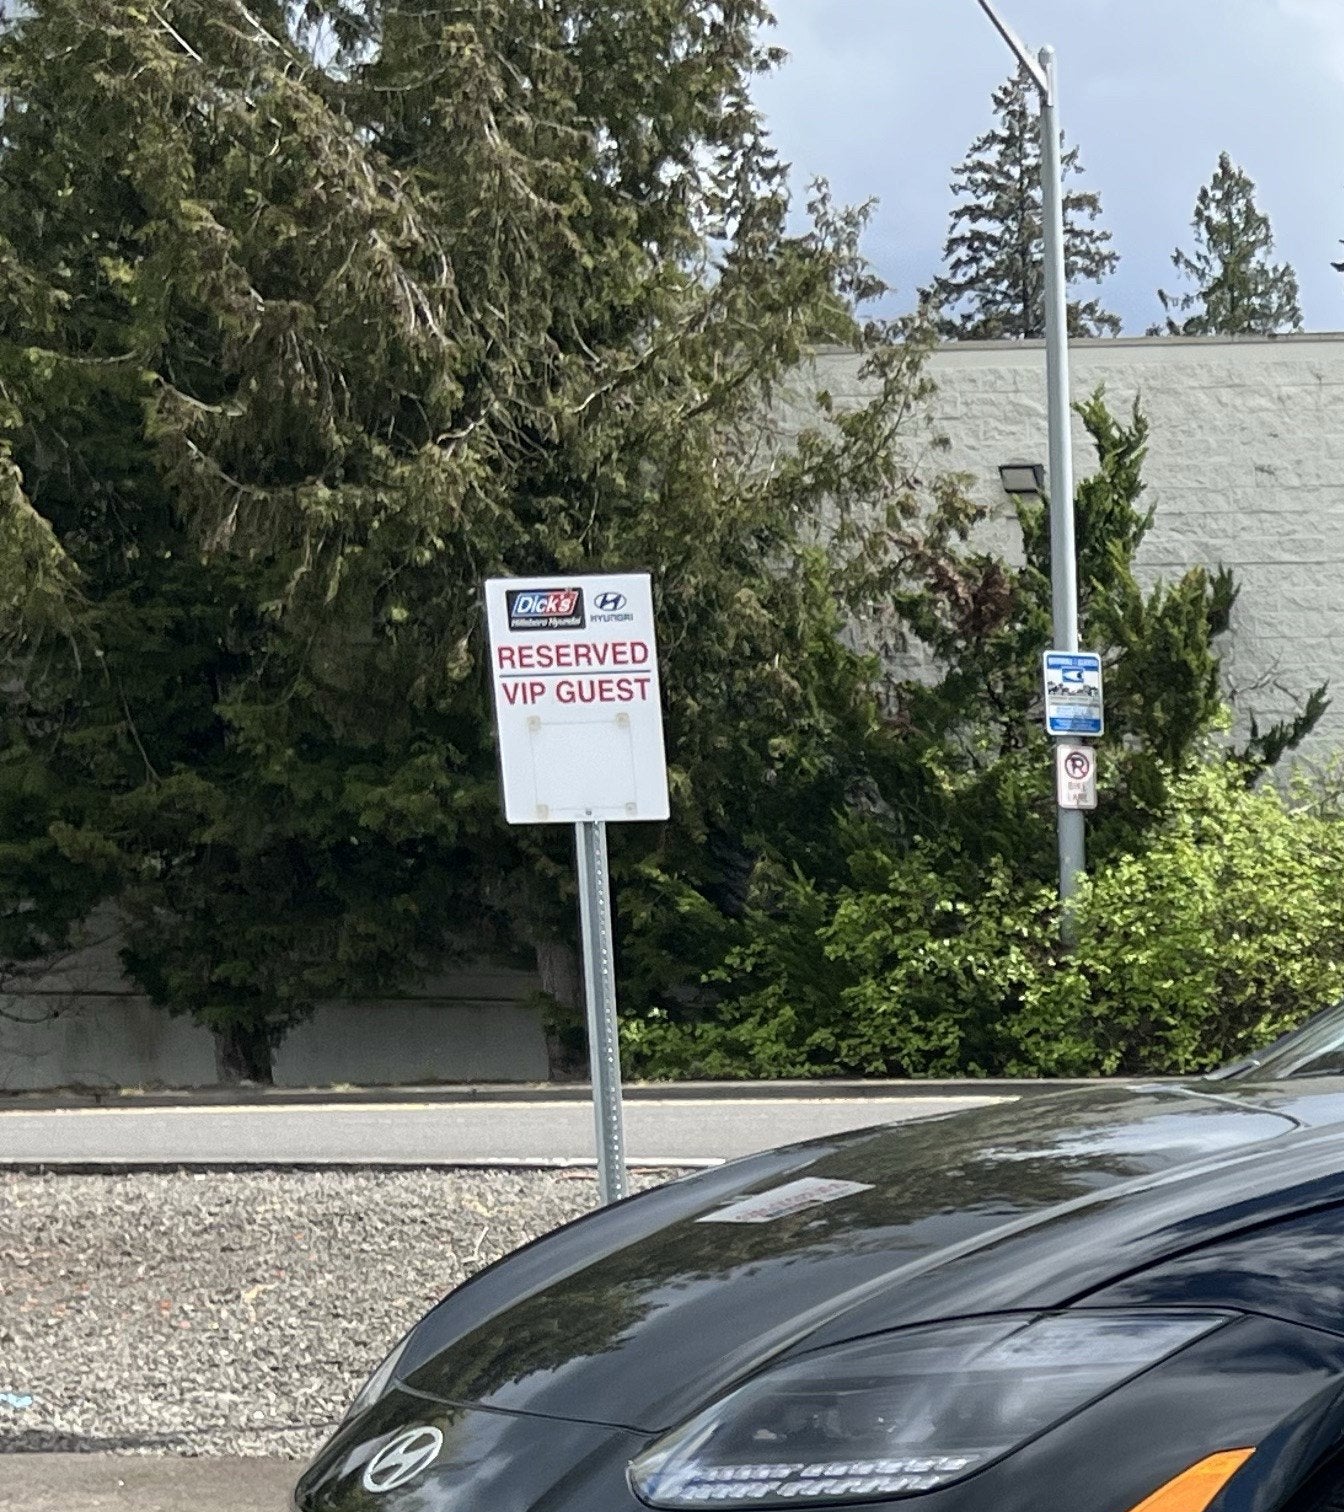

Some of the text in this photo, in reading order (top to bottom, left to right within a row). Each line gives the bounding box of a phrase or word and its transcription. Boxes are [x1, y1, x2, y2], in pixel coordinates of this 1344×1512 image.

[516, 594, 571, 613] Dick's
[590, 613, 634, 622] HYUNDAI
[498, 641, 649, 669] RESERVED
[502, 677, 652, 705] VIP GUEST
